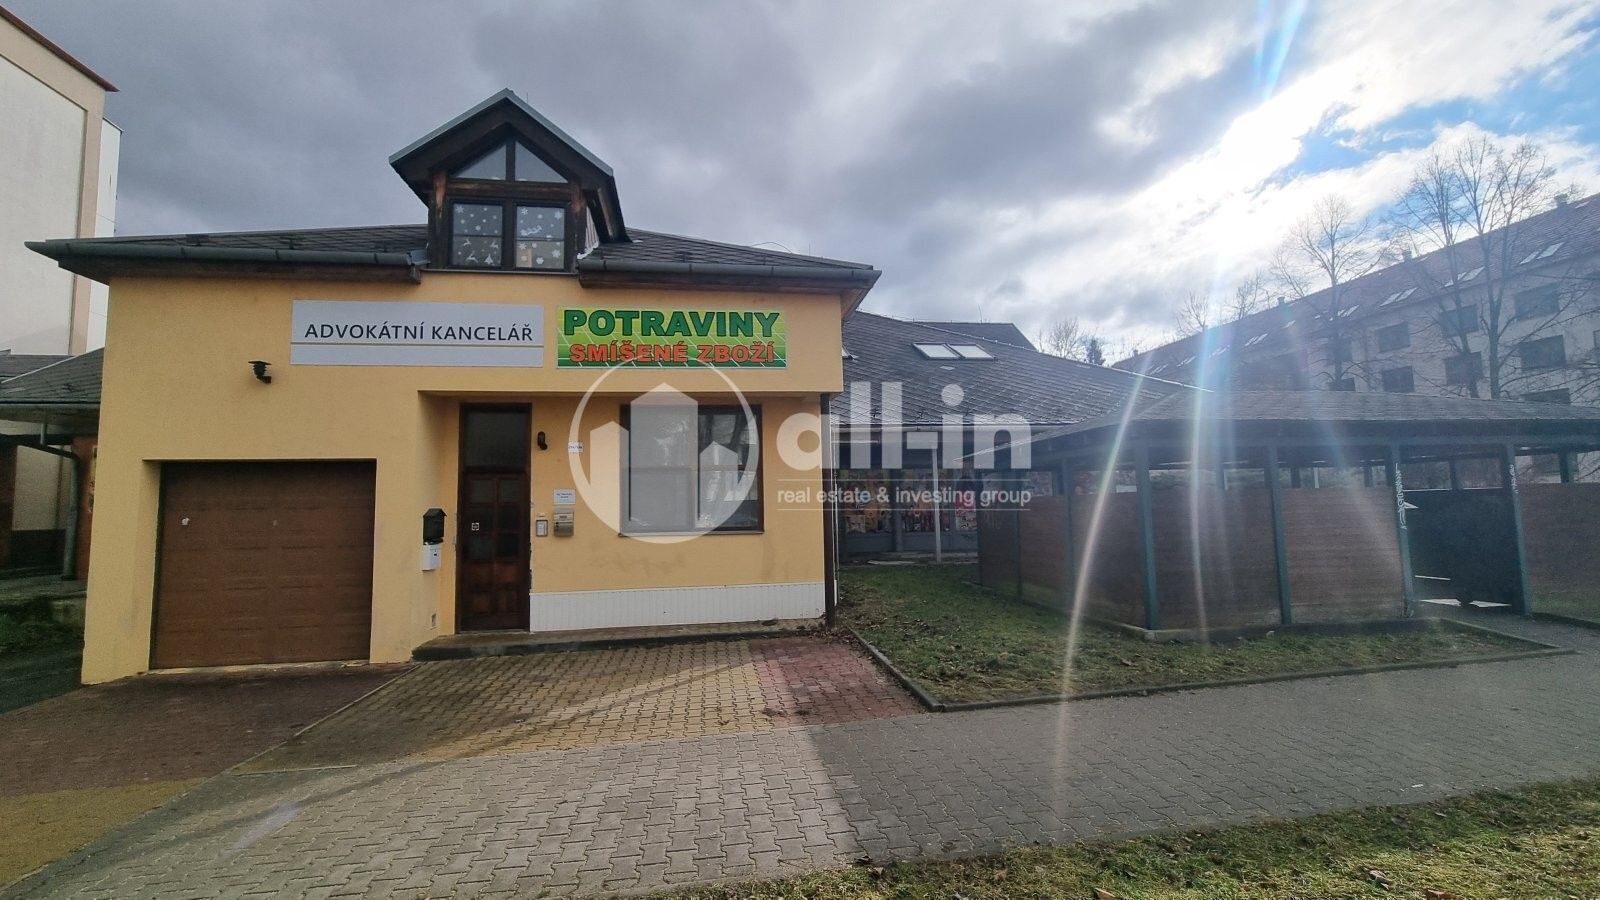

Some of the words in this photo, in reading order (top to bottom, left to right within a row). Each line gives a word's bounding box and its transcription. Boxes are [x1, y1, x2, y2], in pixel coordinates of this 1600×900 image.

[304, 320, 425, 340] ADVOKÁTNÍ
[431, 322, 533, 342] KANCELÁŘ
[563, 309, 779, 338] POTRAVINY
[569, 341, 688, 364] SMÍŠENÉ
[696, 341, 775, 364] ZBOŽÍ
